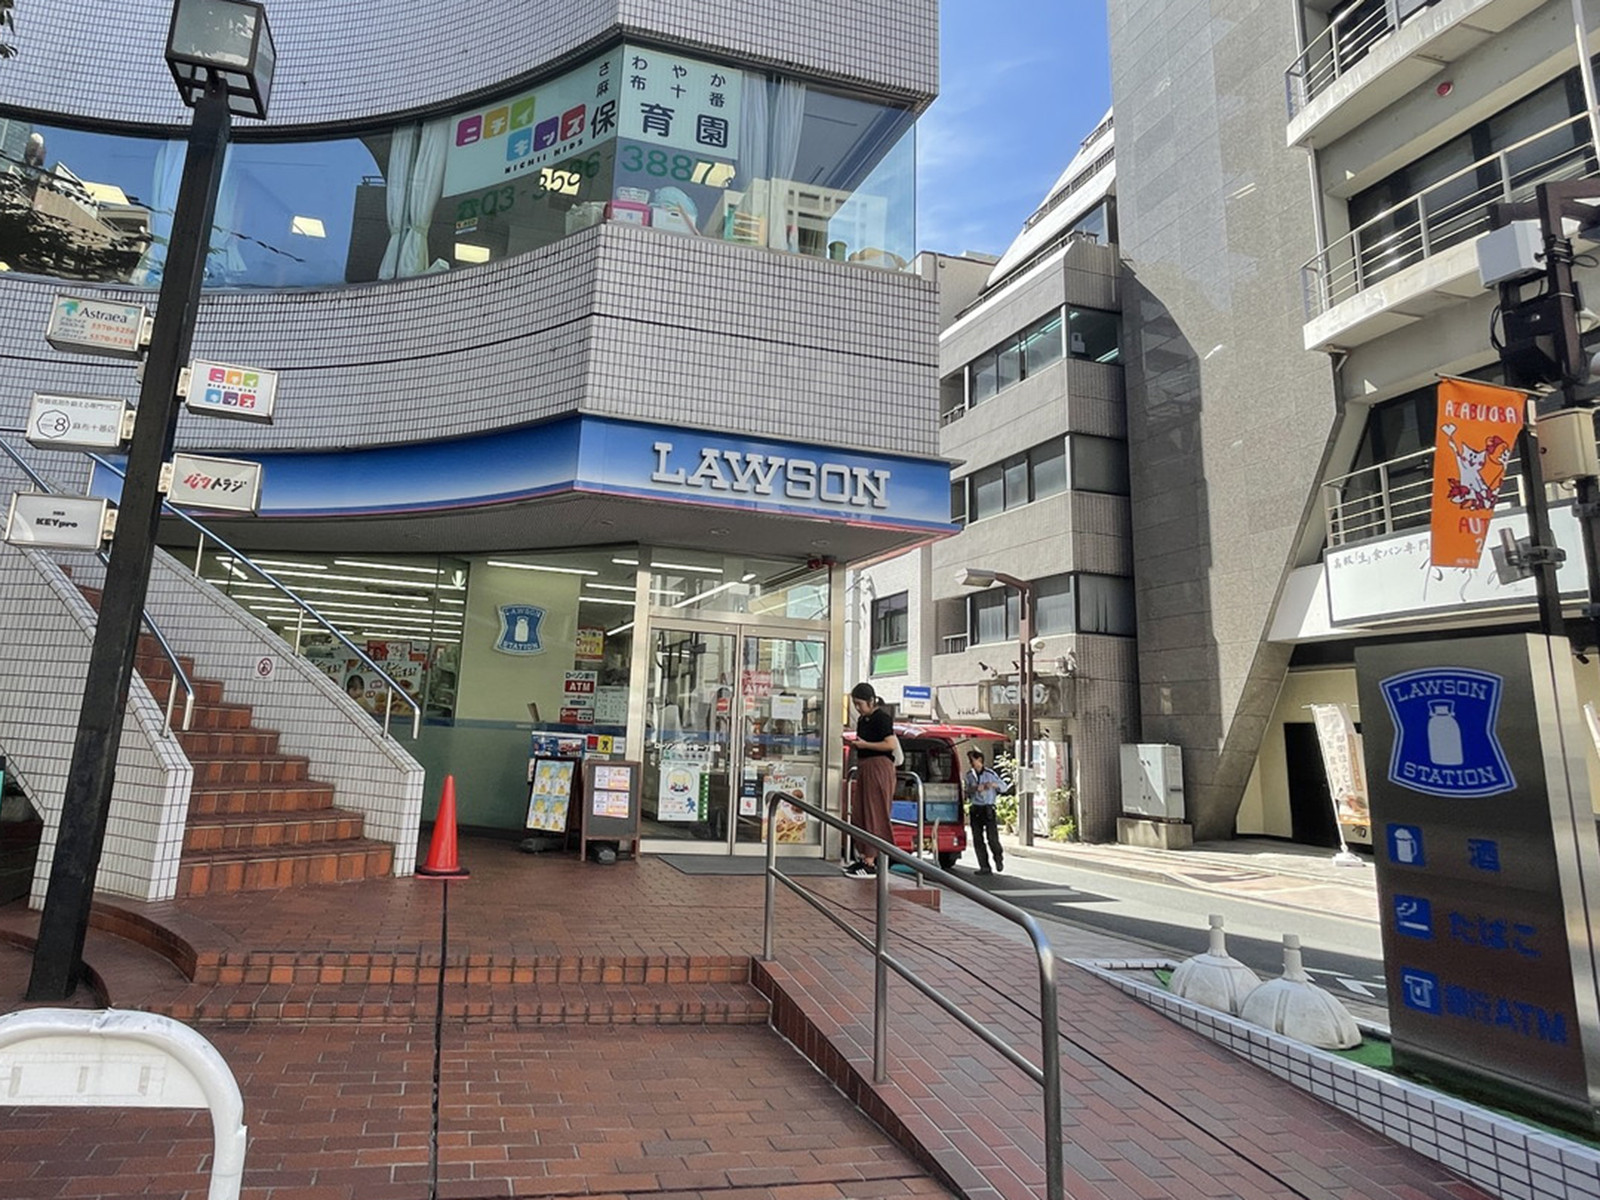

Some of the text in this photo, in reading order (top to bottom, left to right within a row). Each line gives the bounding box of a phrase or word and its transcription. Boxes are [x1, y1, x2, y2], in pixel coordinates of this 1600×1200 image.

[459, 102, 534, 145] ニチイ
[510, 109, 585, 160] キッズ
[504, 138, 584, 174] NICHII KIDS
[79, 307, 127, 324] Astraea
[54, 417, 66, 432] 8
[652, 442, 891, 508] LAWSON
[36, 518, 78, 528] KEYpro
[504, 608, 541, 617] LAWSON
[503, 641, 539, 650] STATION
[569, 682, 590, 691] ATM
[1395, 680, 1488, 702] LAWSON
[1404, 761, 1498, 786] STATION
[1468, 838, 1500, 872] 酒
[1449, 911, 1542, 958] たばこ
